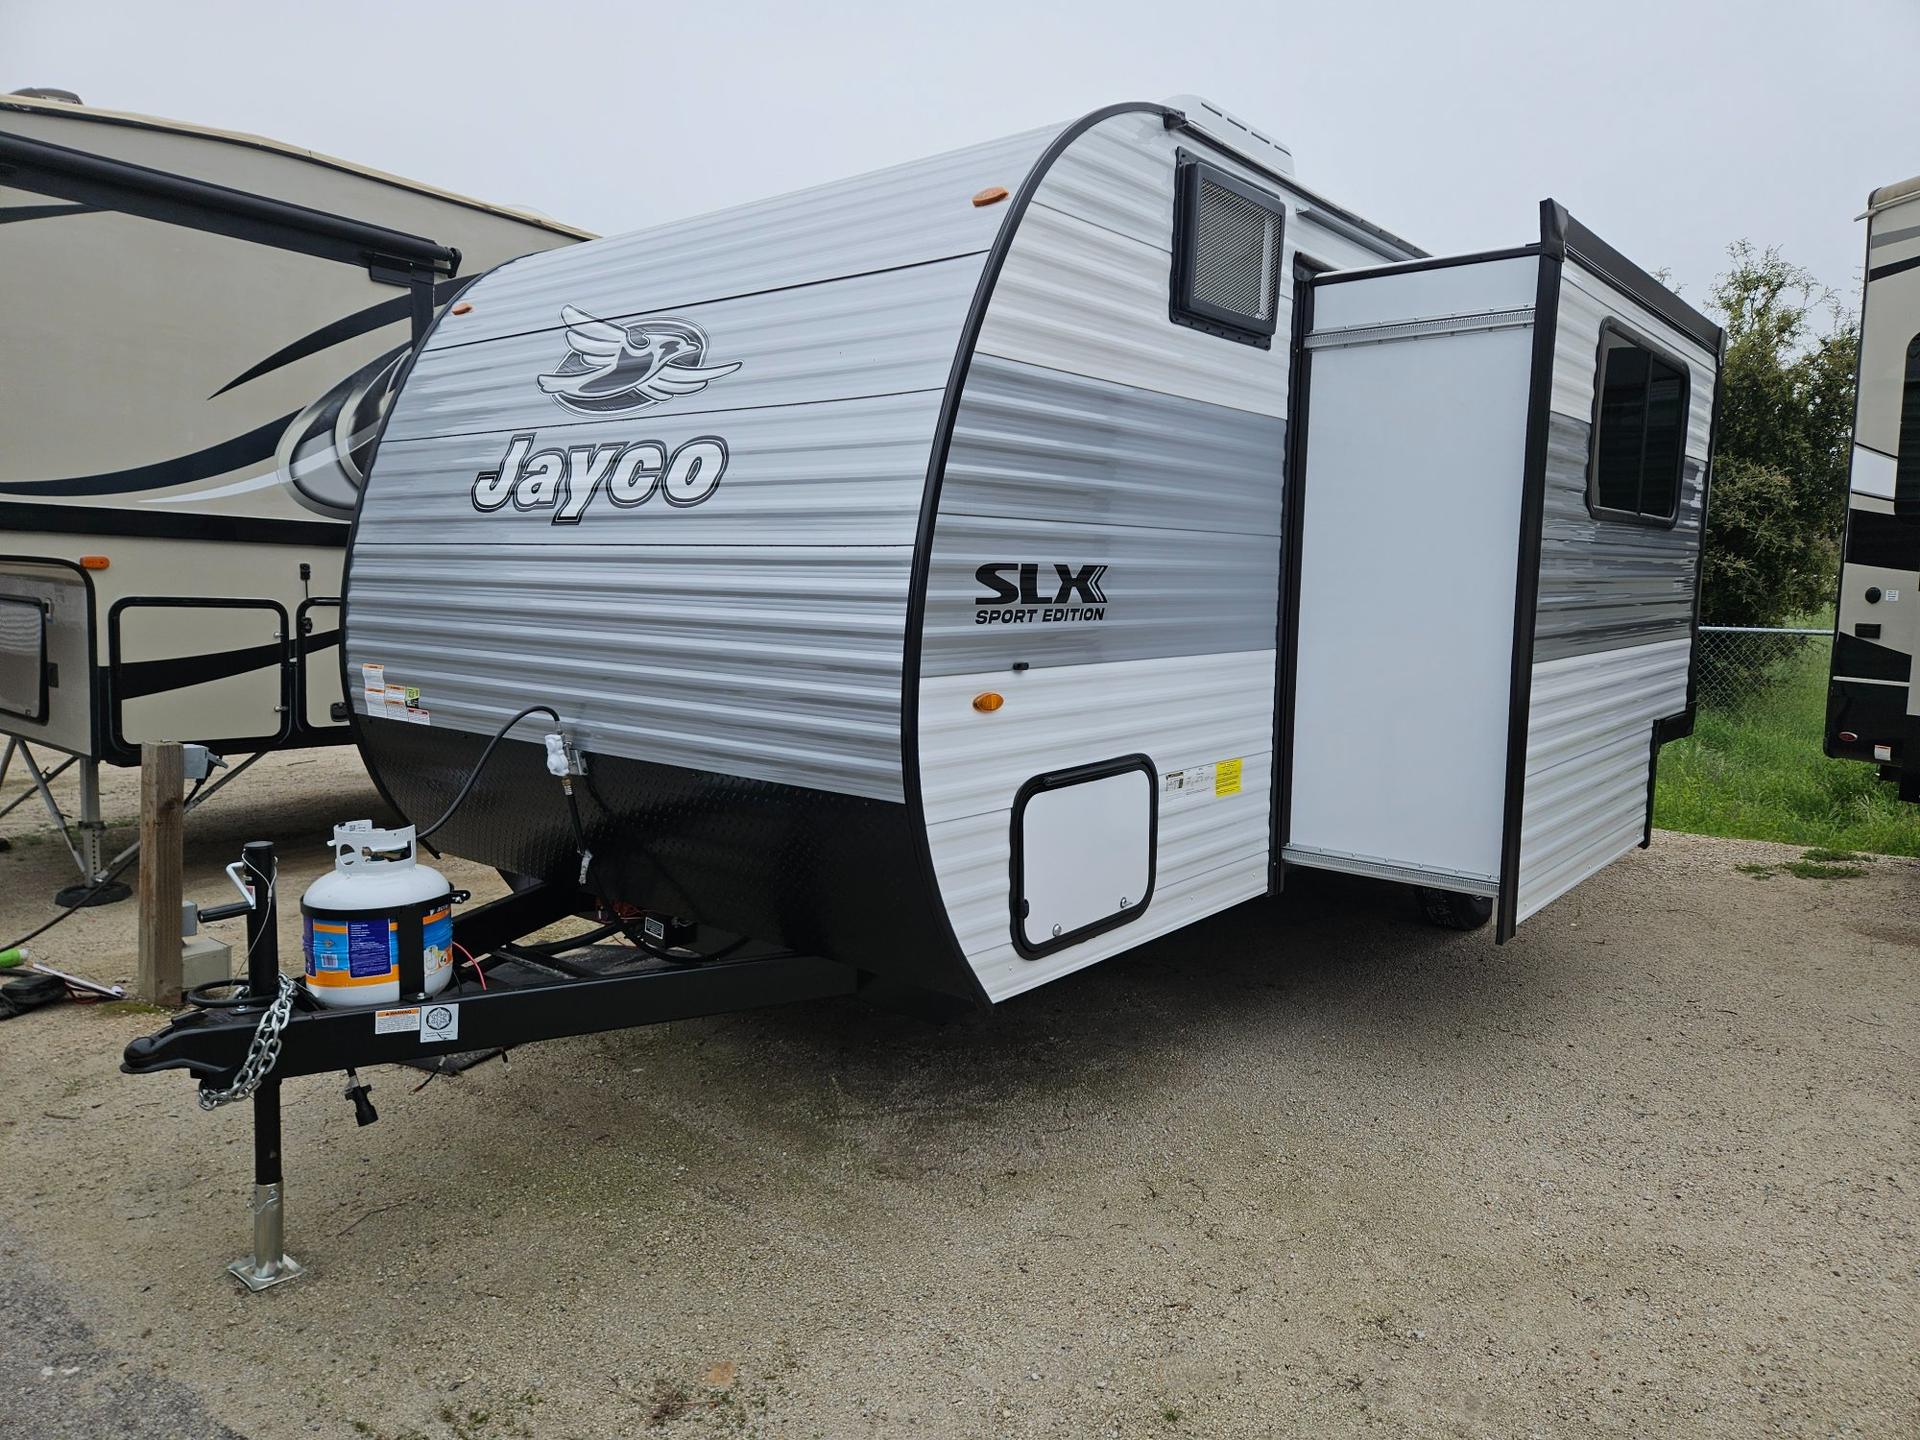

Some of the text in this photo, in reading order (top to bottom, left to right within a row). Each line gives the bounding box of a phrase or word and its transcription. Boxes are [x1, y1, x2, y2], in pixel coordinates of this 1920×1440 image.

[471, 432, 729, 526] Jayco
[975, 563, 1108, 605] SLX
[975, 607, 1106, 625] SPORT EDITION
